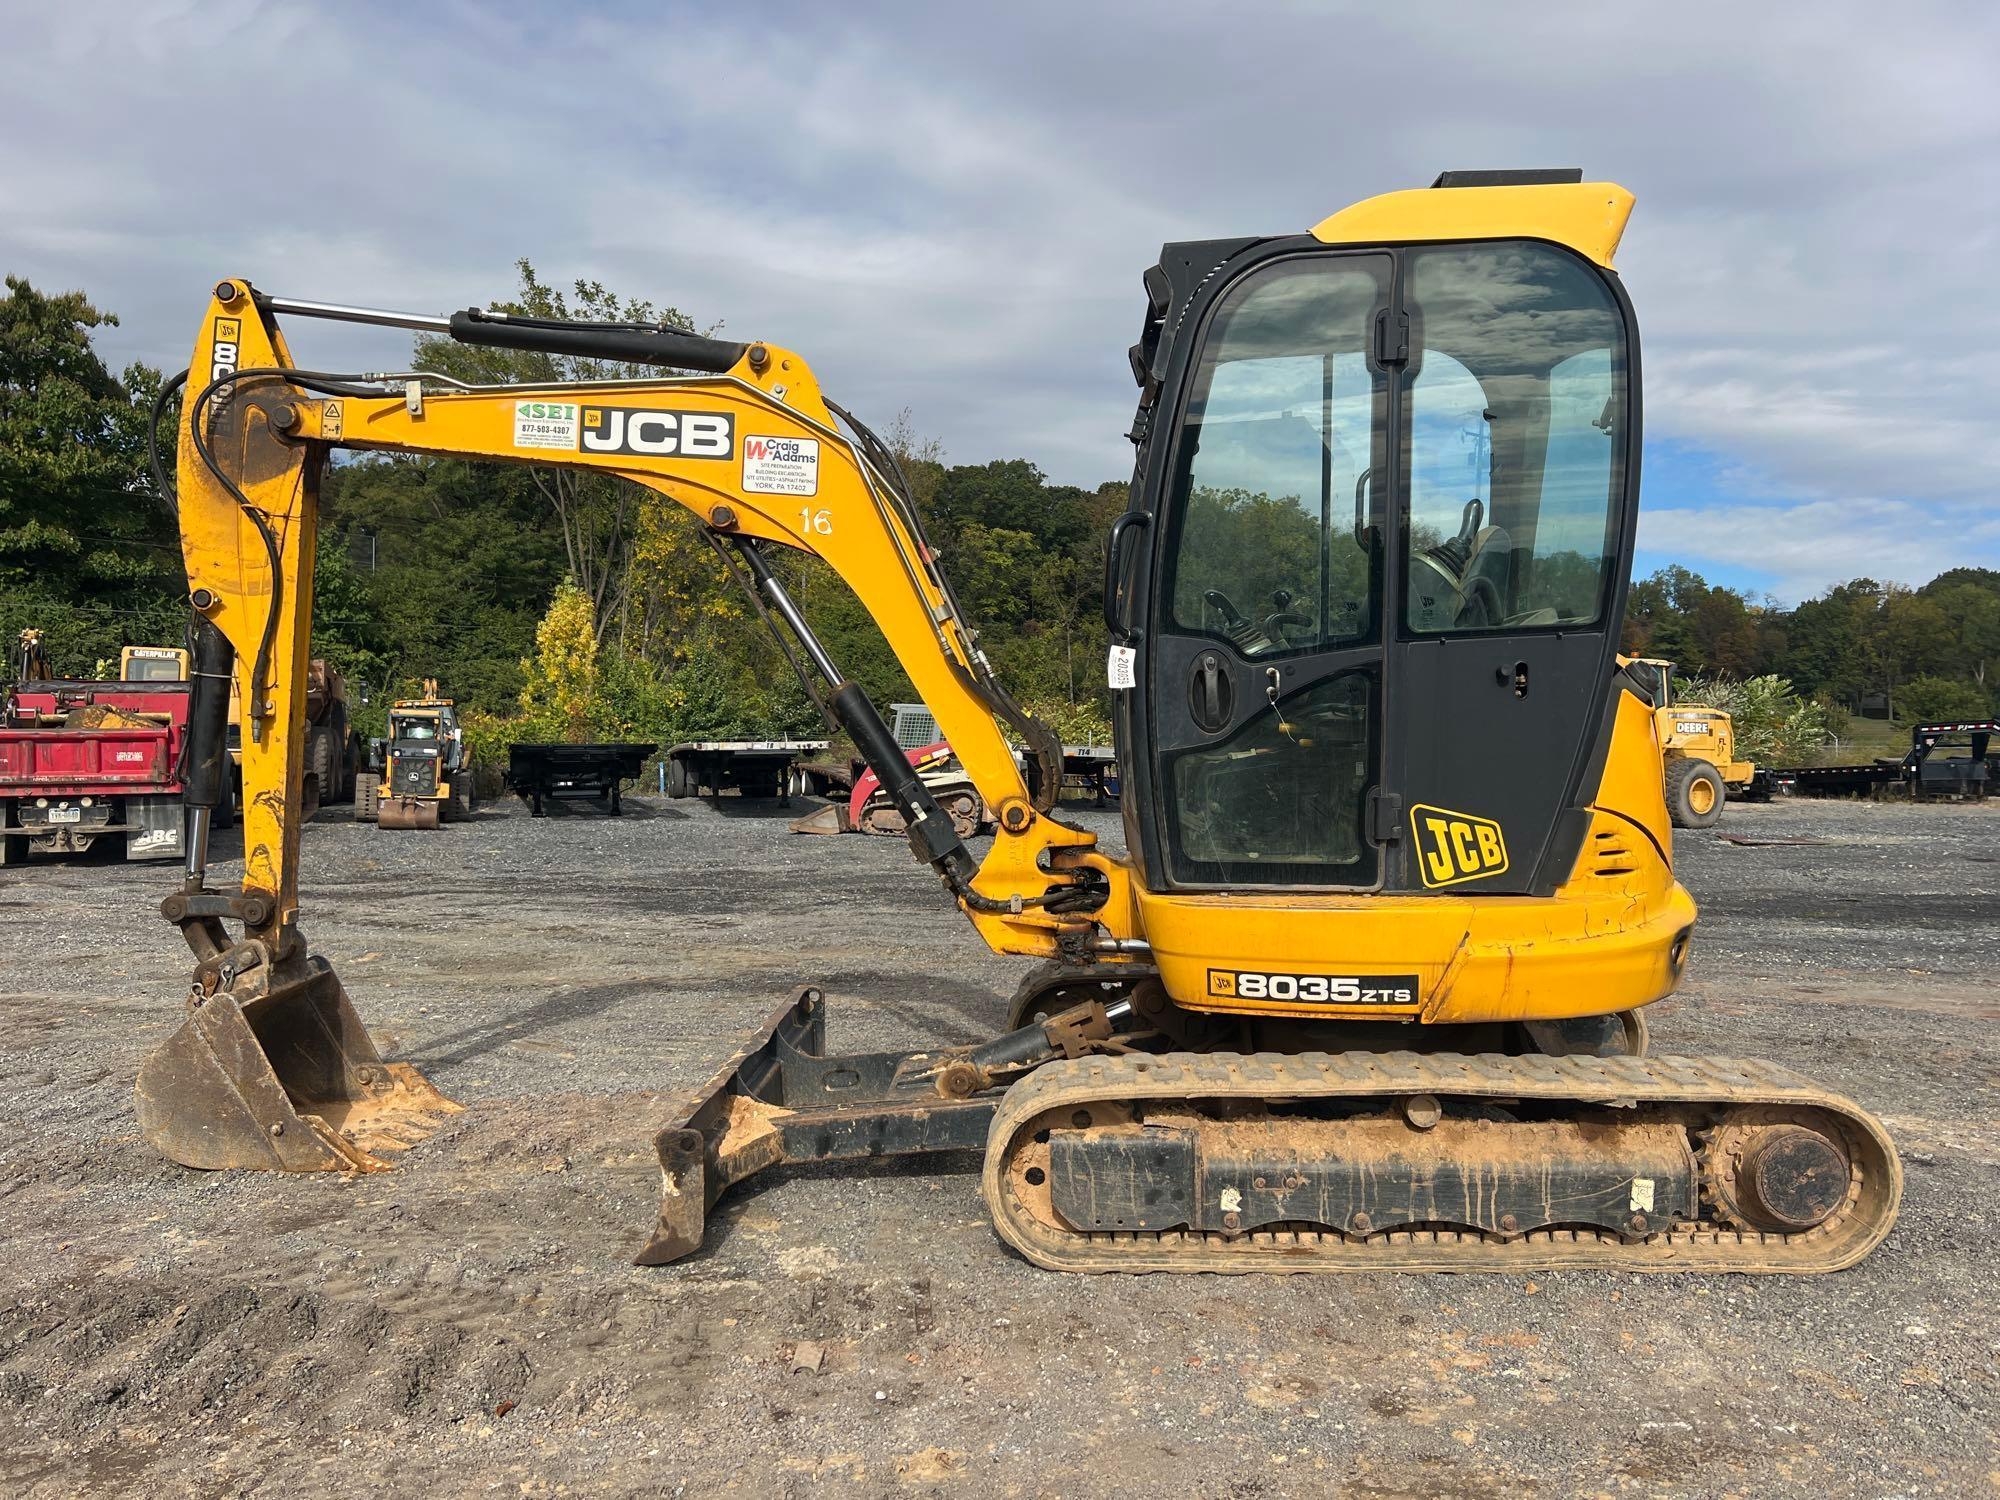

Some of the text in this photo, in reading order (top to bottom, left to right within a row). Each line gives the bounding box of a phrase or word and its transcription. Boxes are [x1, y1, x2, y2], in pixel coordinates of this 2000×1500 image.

[532, 404, 574, 420] SEI
[584, 411, 730, 456] JCB
[766, 439, 799, 454] Craig
[772, 450, 816, 463] Adams
[755, 482, 775, 490] YORK,
[800, 506, 832, 535] 16
[134, 649, 176, 658] CATERPILLAR
[1677, 722, 1708, 733] DEERE
[1425, 818, 1502, 881] JCB
[1213, 973, 1411, 1002] JCB 8035 ZTS
